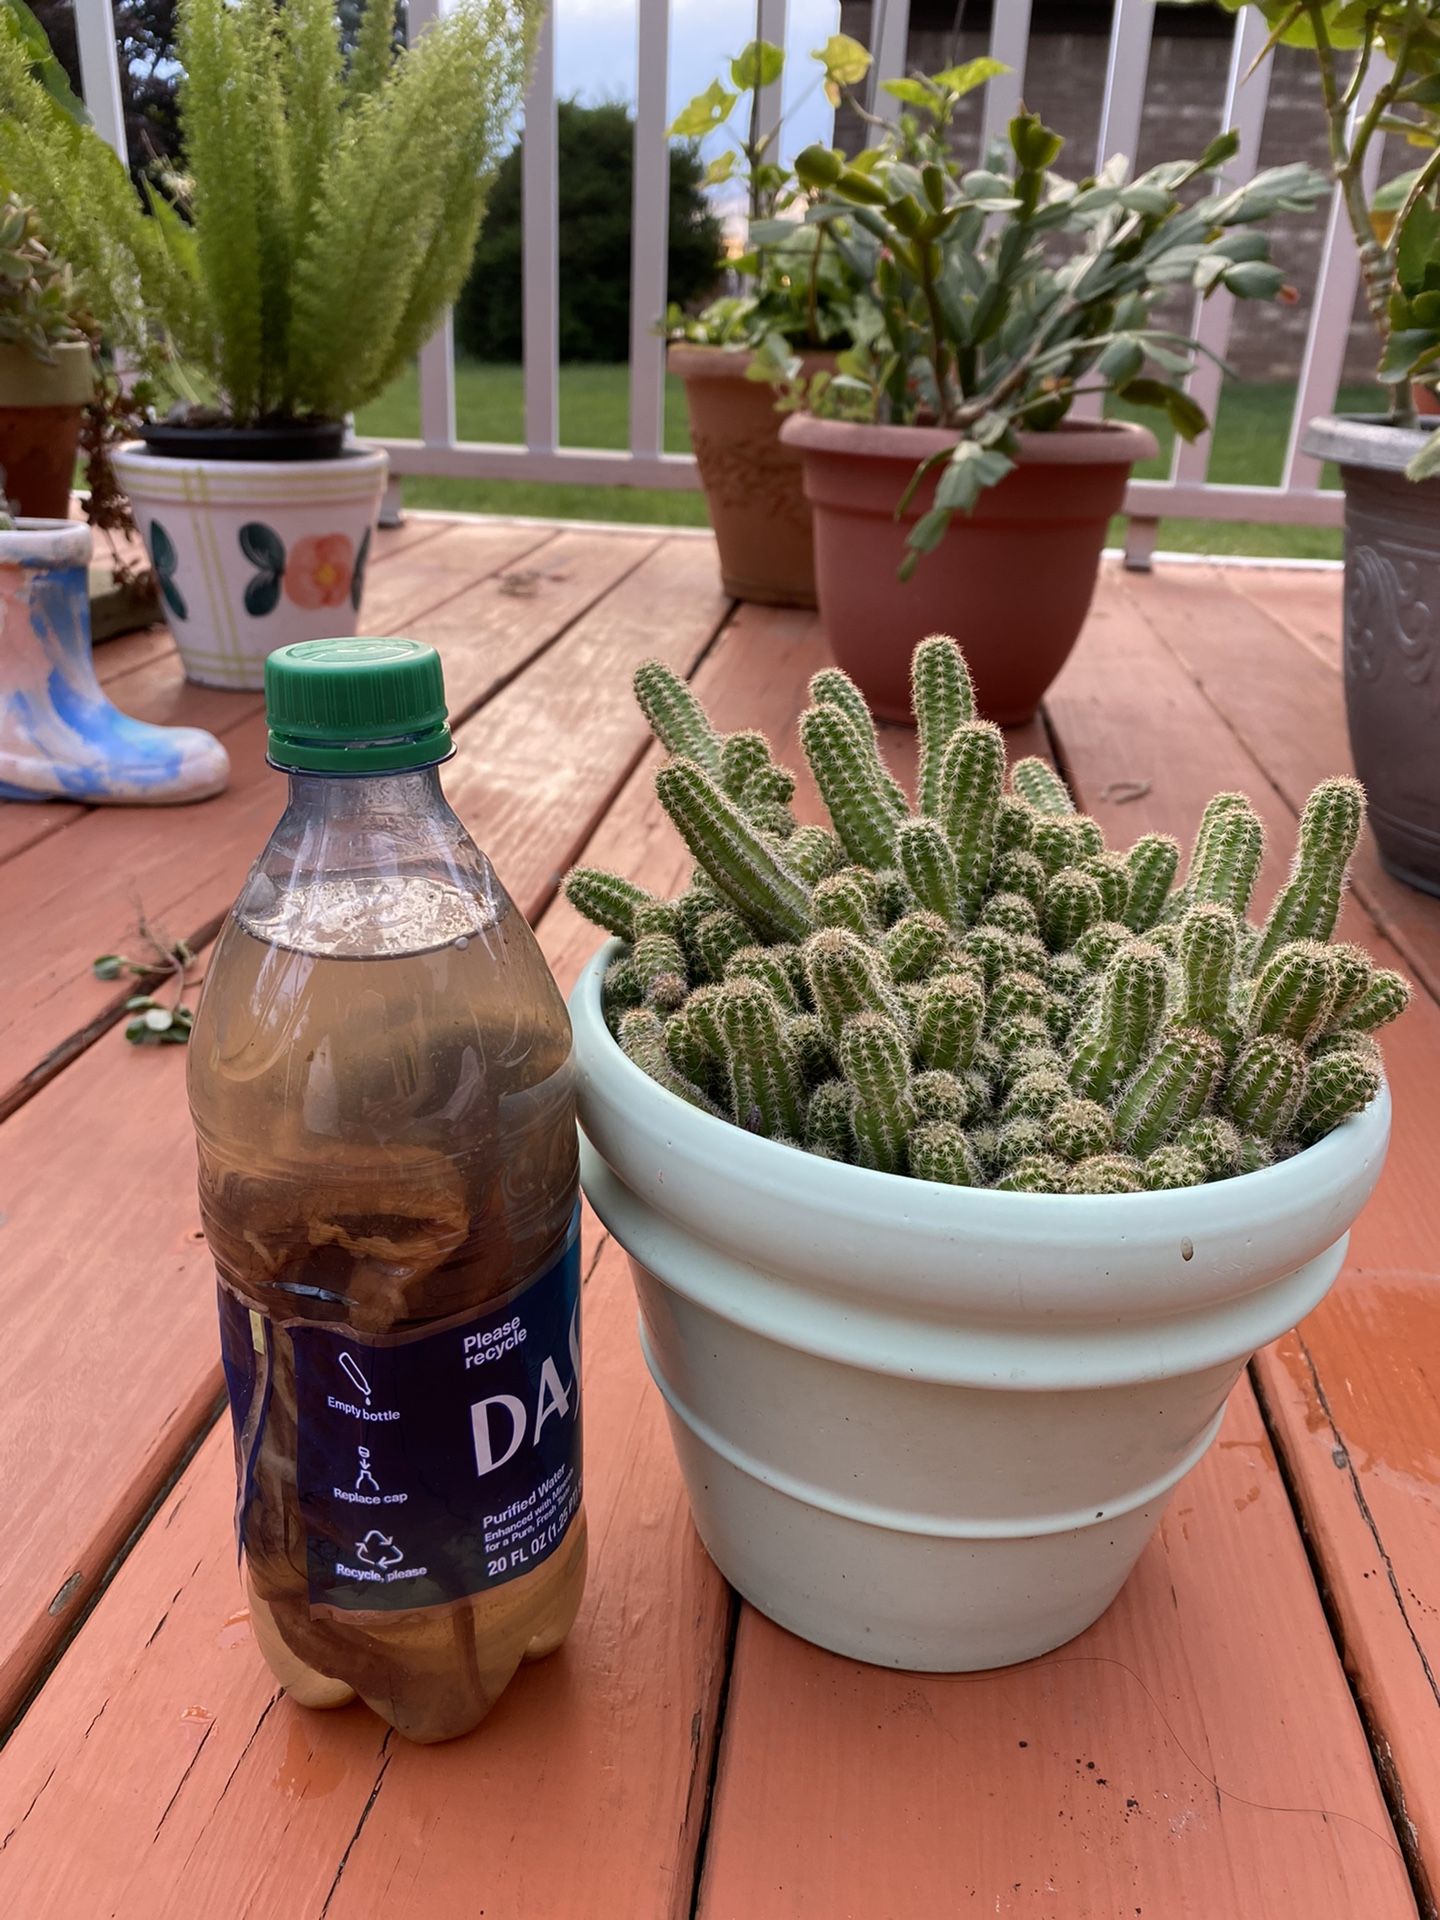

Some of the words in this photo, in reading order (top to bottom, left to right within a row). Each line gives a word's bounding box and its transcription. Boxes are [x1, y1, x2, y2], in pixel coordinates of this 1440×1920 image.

[463, 1316, 520, 1353] Please
[465, 1328, 527, 1370] recycle
[327, 1396, 361, 1419] Empty
[362, 1408, 400, 1422] bottle
[334, 1487, 380, 1505] Replace
[384, 1492, 408, 1504] cap
[483, 1491, 536, 1529] Purified
[538, 1463, 565, 1498] Water
[485, 1512, 534, 1542] Enhanced
[534, 1498, 552, 1516] with
[485, 1541, 501, 1553] for
[502, 1538, 510, 1546] a
[511, 1525, 535, 1543] Pure,
[536, 1504, 557, 1527] Fresh
[487, 1556, 507, 1577] 20
[510, 1548, 529, 1567] FL
[531, 1532, 547, 1555] OZ
[548, 1507, 568, 1542] (1.25
[335, 1563, 384, 1583] Recycle,
[386, 1566, 428, 1583] please
